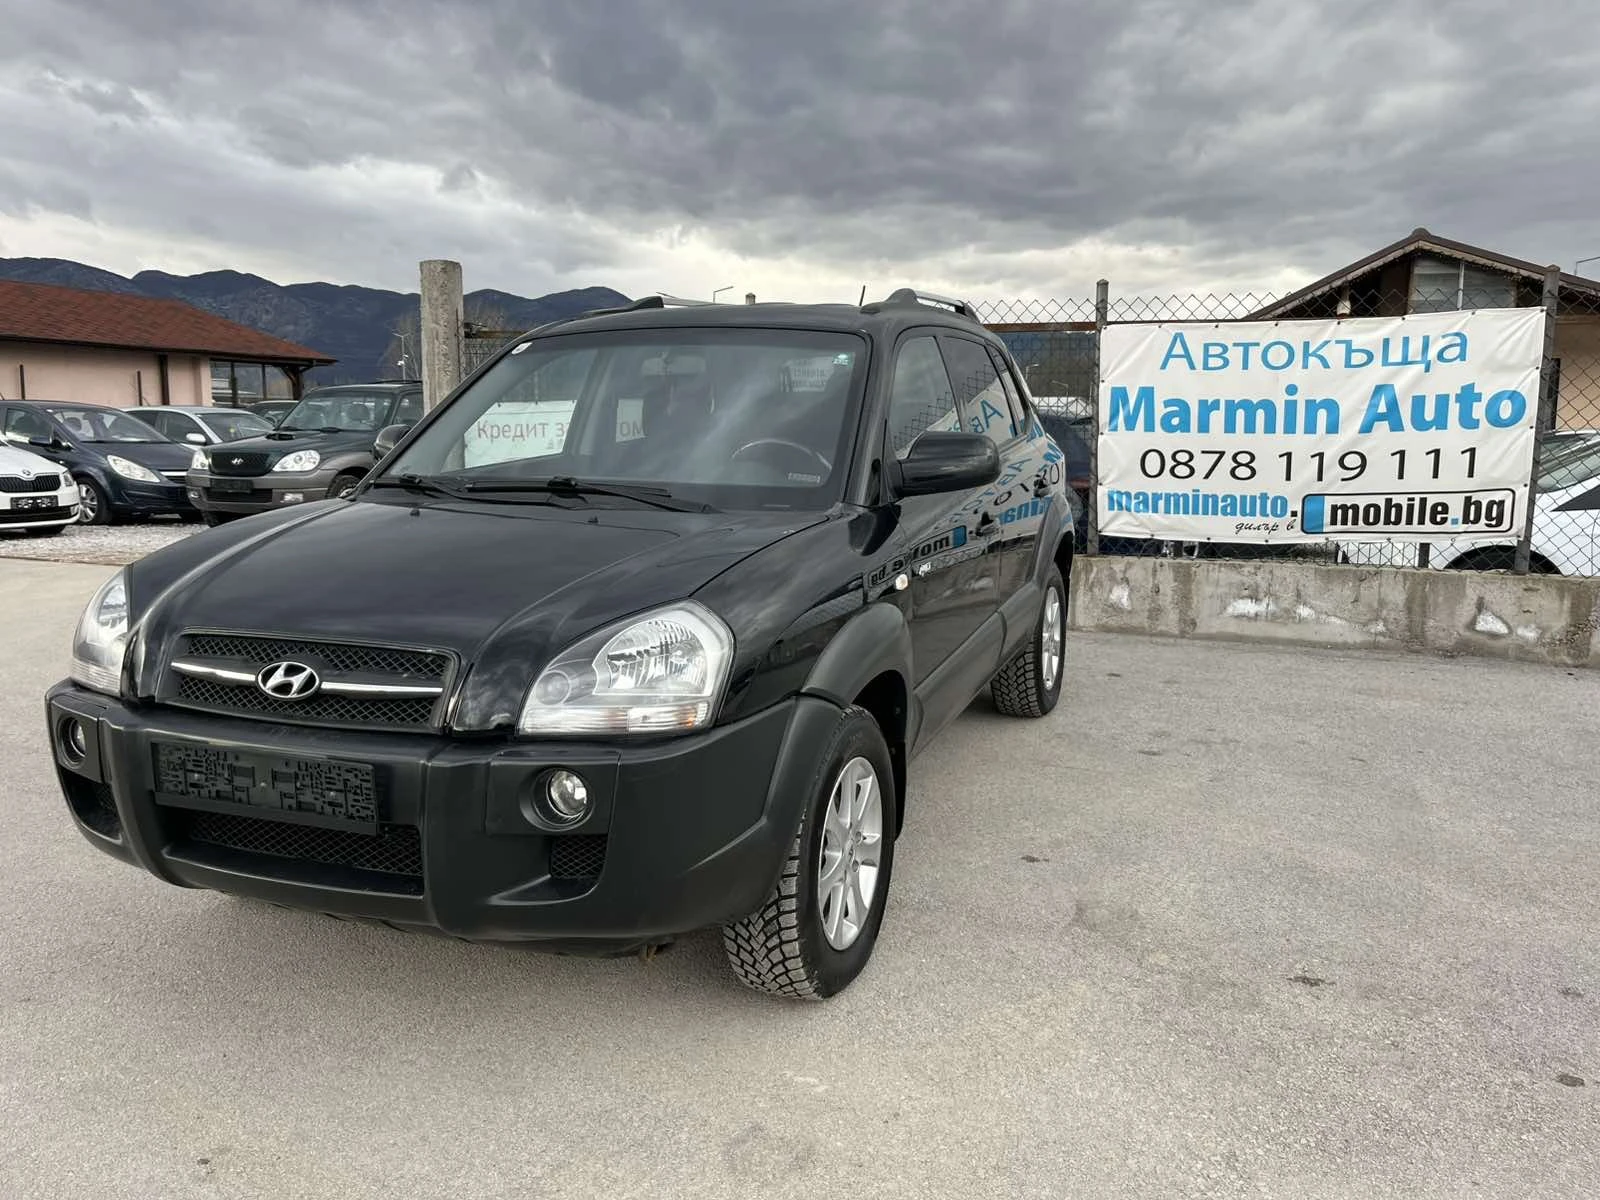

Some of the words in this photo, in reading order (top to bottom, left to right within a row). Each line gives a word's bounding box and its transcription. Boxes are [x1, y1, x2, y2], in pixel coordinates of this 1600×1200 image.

[1160, 331, 1468, 373] Автокъща
[1107, 383, 1340, 435] Marmin
[1358, 382, 1527, 434] Auto
[477, 420, 549, 443] Кредит
[555, 421, 569, 439] з
[1140, 448, 1257, 481] 0878
[1278, 450, 1367, 482] 119
[1390, 446, 1477, 480] 111
[1329, 495, 1505, 528] mobile.bg
